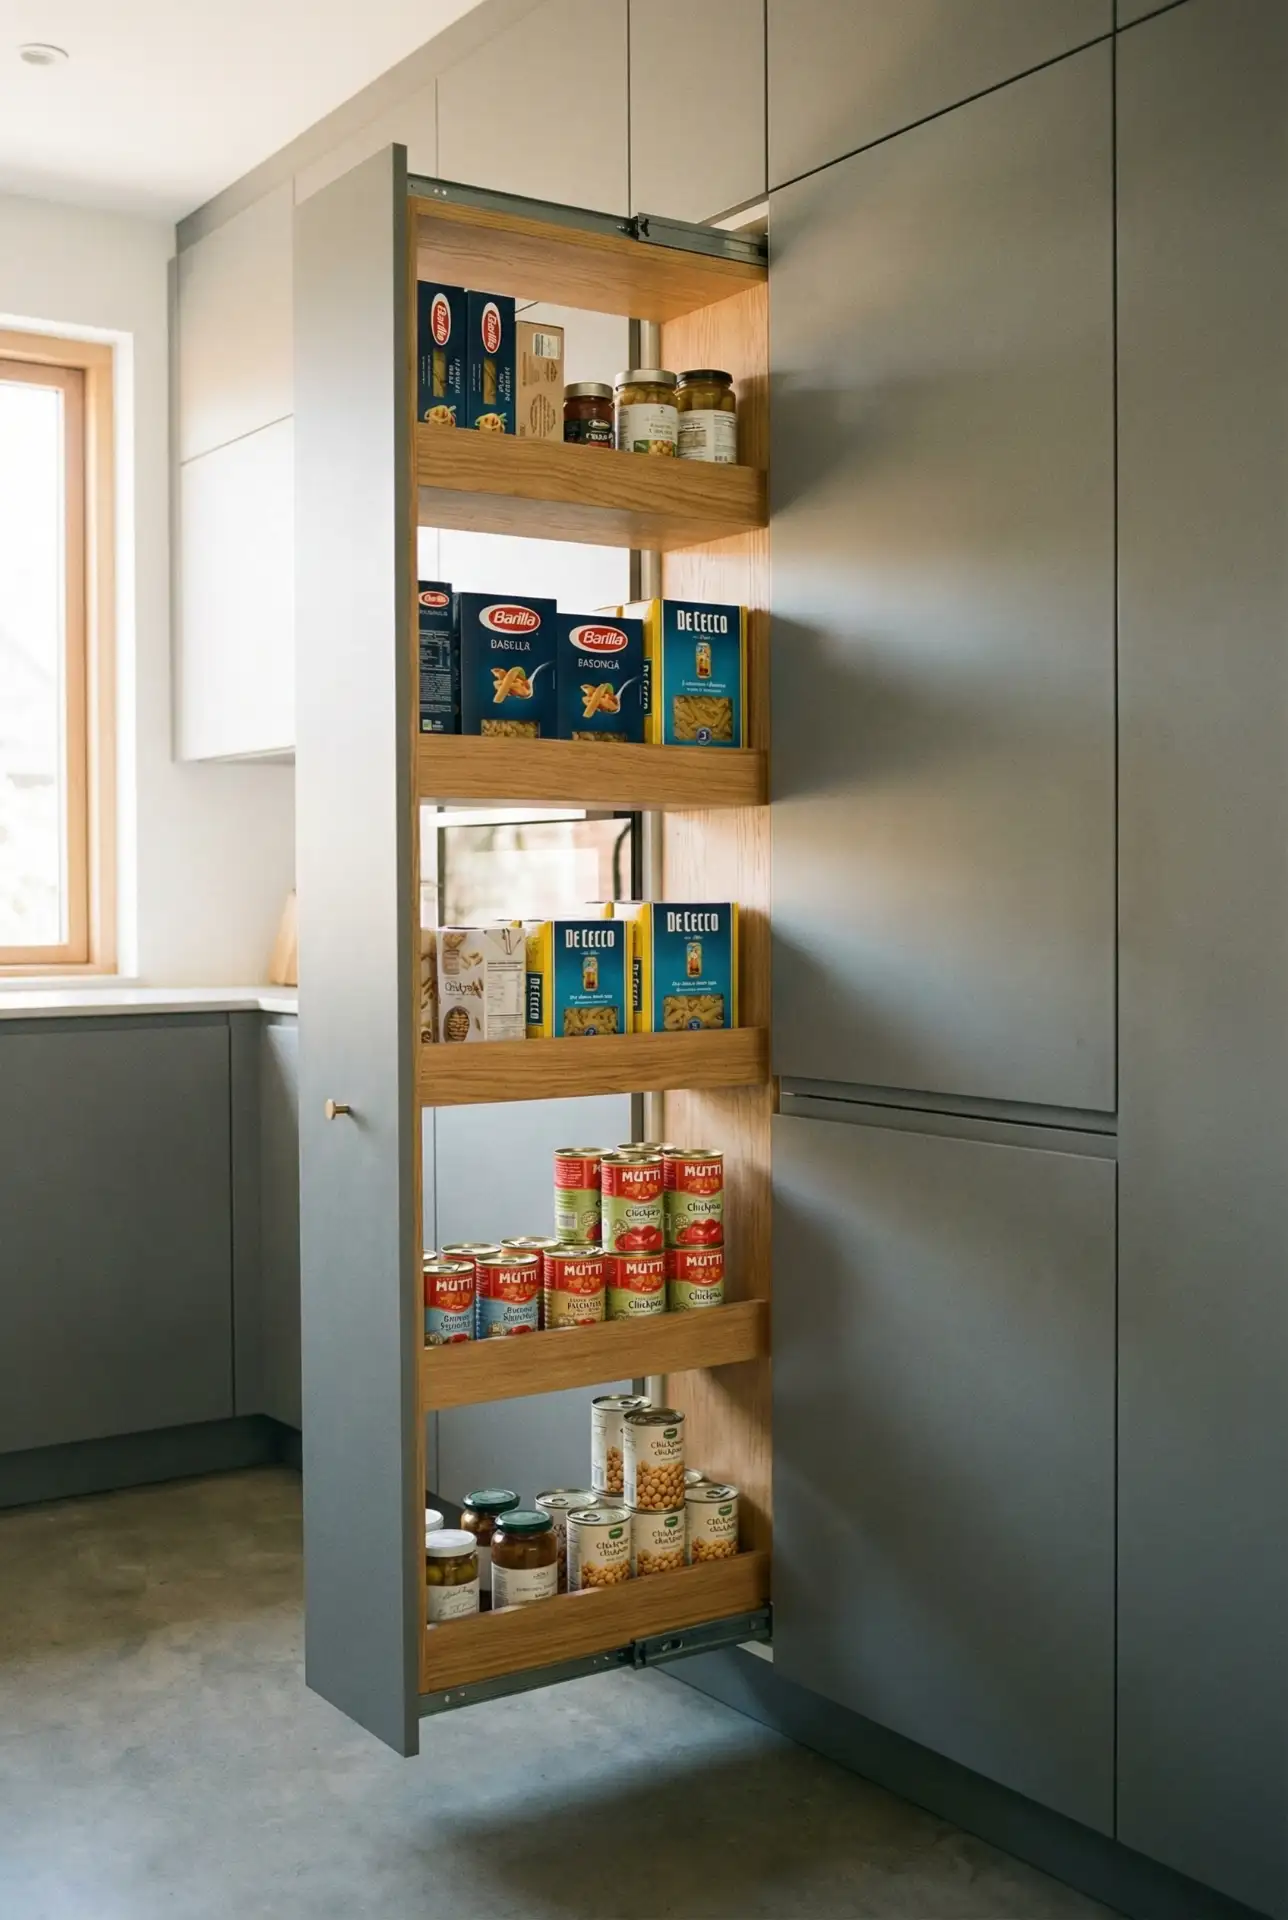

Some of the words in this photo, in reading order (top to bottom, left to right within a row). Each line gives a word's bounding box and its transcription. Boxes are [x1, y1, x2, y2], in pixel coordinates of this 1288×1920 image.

[493, 610, 536, 627] Barilla
[693, 611, 728, 634] CECCO
[583, 630, 624, 646] Barilla
[684, 911, 719, 932] CECCO
[582, 929, 615, 948] CECCO
[622, 1169, 661, 1183] MUTTI
[684, 1164, 722, 1177] MUTTI
[686, 1254, 723, 1267] MUTTI
[564, 1262, 603, 1276] MUTTI
[626, 1261, 665, 1275] MUTTI
[499, 1270, 537, 1284] MUTTI
[436, 1277, 473, 1292] MUTTI
